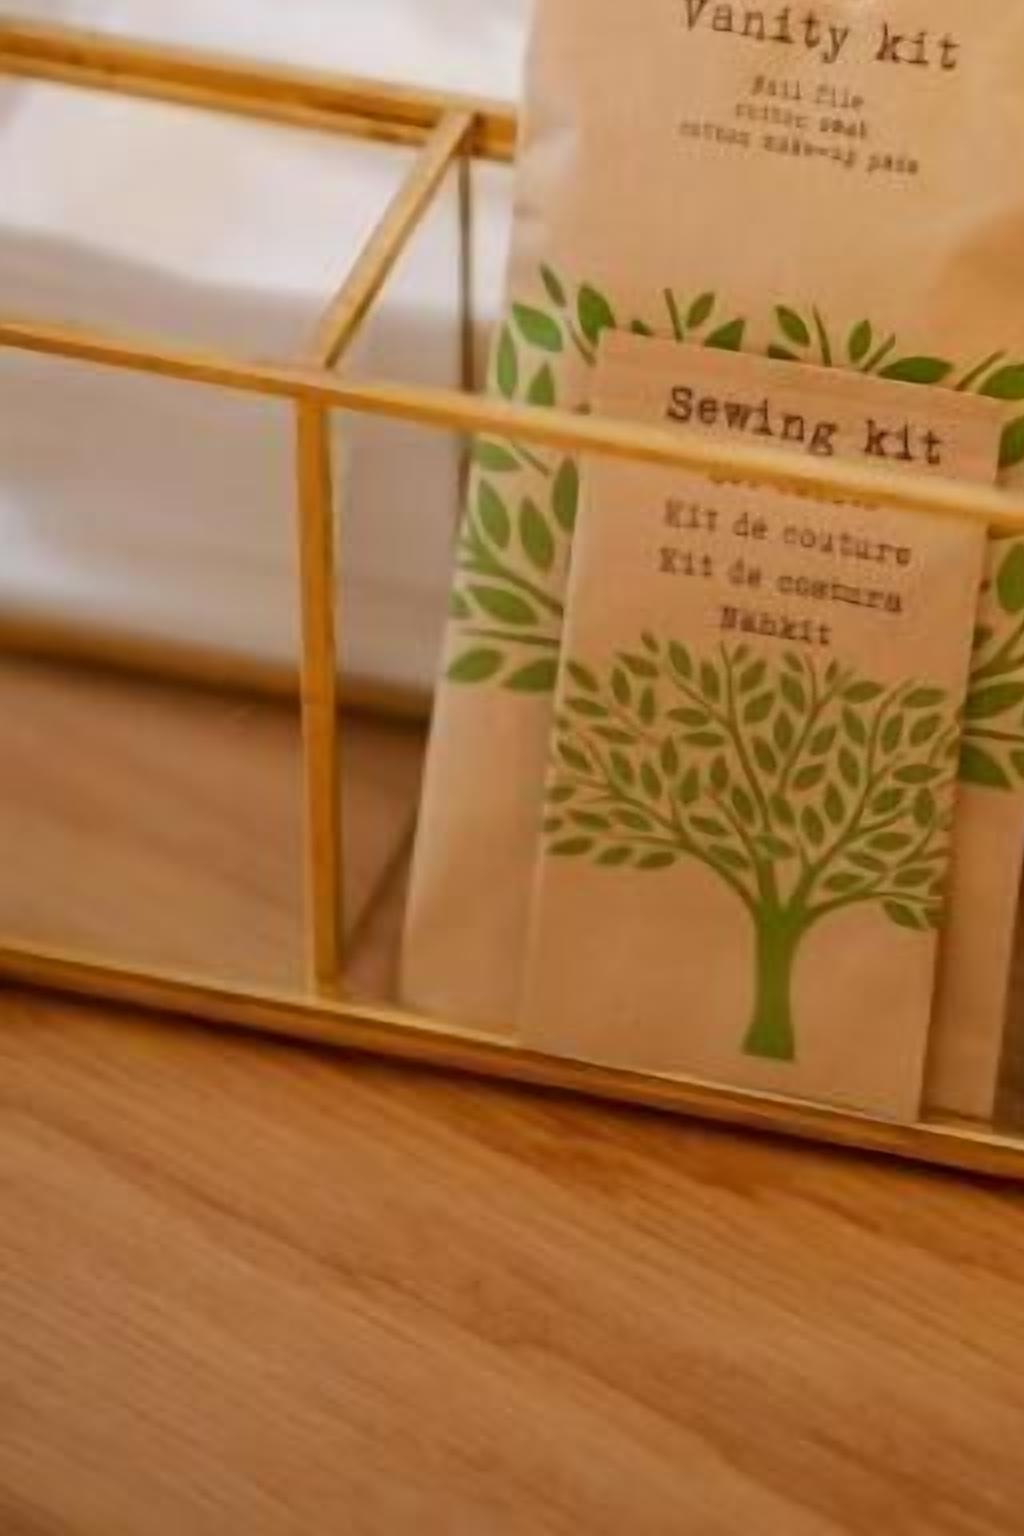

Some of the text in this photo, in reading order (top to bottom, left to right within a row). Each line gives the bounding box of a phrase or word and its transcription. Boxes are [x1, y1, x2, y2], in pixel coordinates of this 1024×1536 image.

[876, 21, 960, 70] kit
[666, 385, 942, 465] Sewing kit
[664, 499, 912, 566] Kit de couture
[658, 547, 903, 612] Kit de costura
